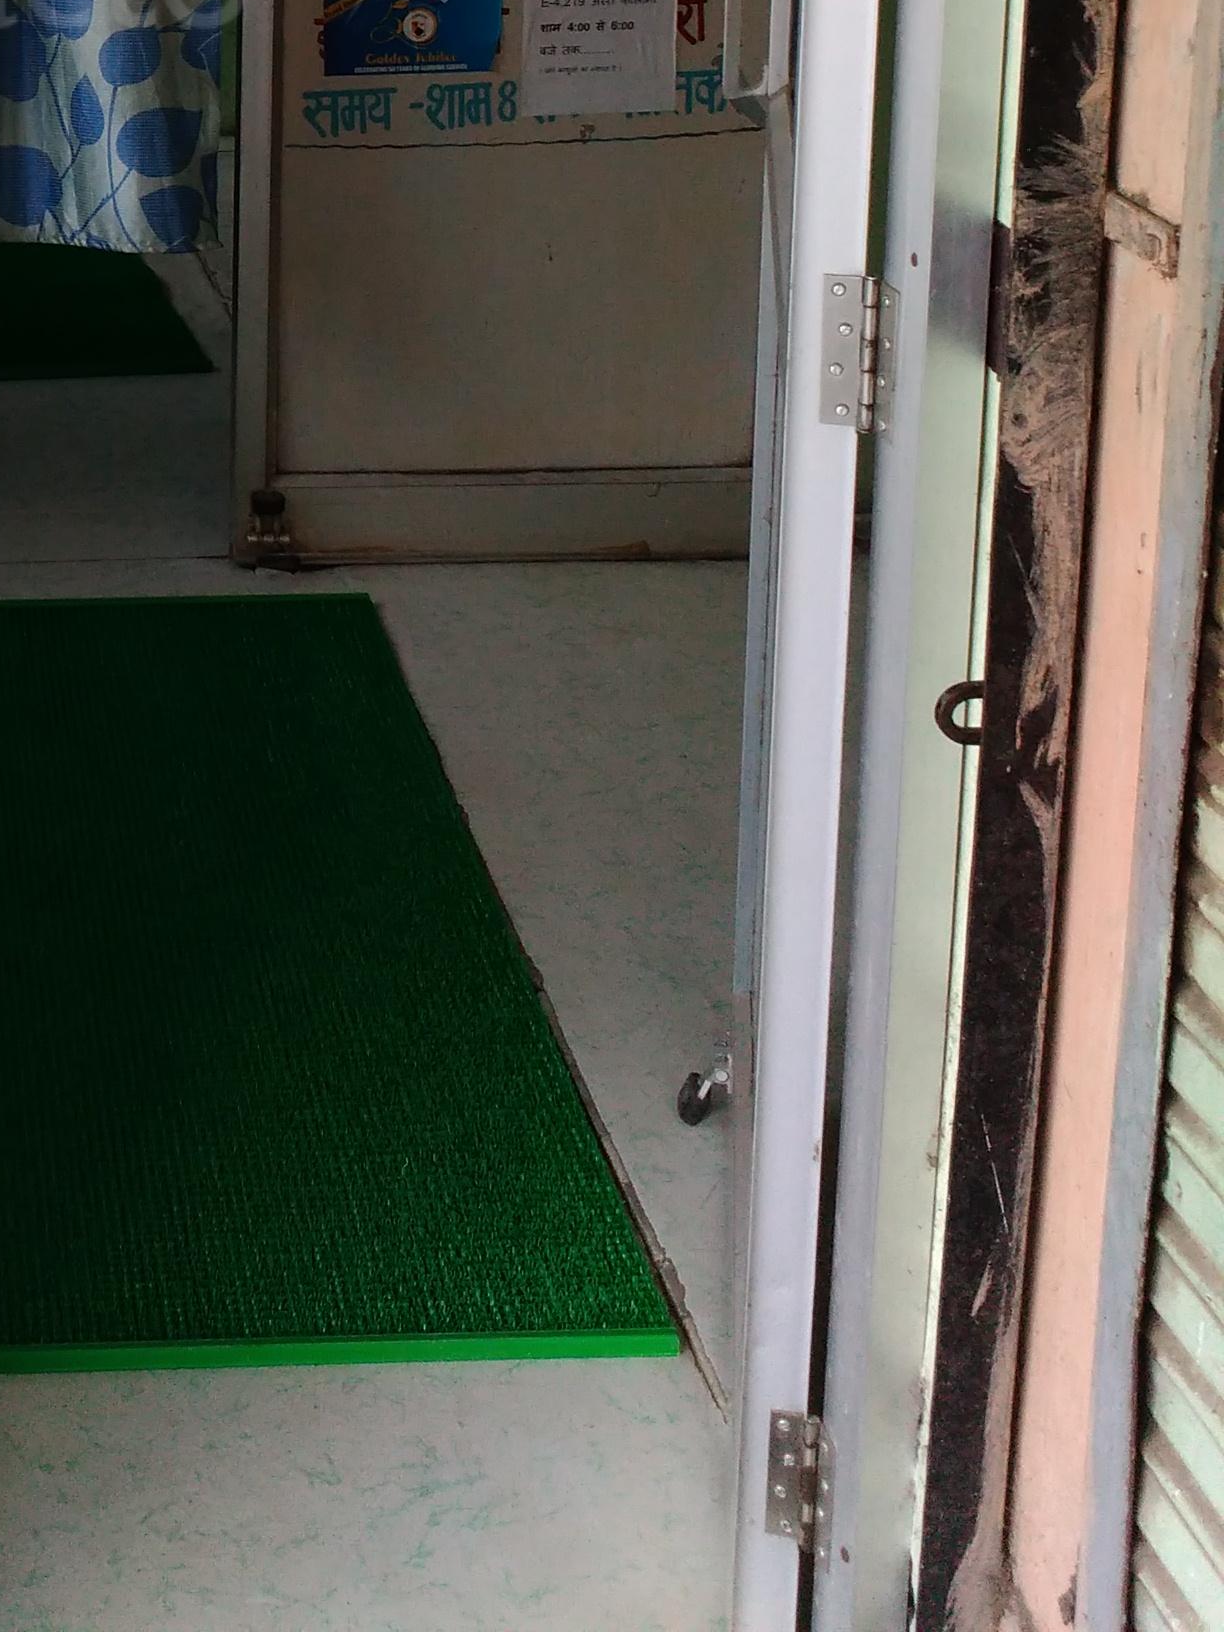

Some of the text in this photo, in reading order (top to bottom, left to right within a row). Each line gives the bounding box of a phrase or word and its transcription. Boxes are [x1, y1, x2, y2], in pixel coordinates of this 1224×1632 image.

[567, 22, 590, 32] 4:00
[303, 84, 397, 138] समय
[496, 80, 518, 124] 8
